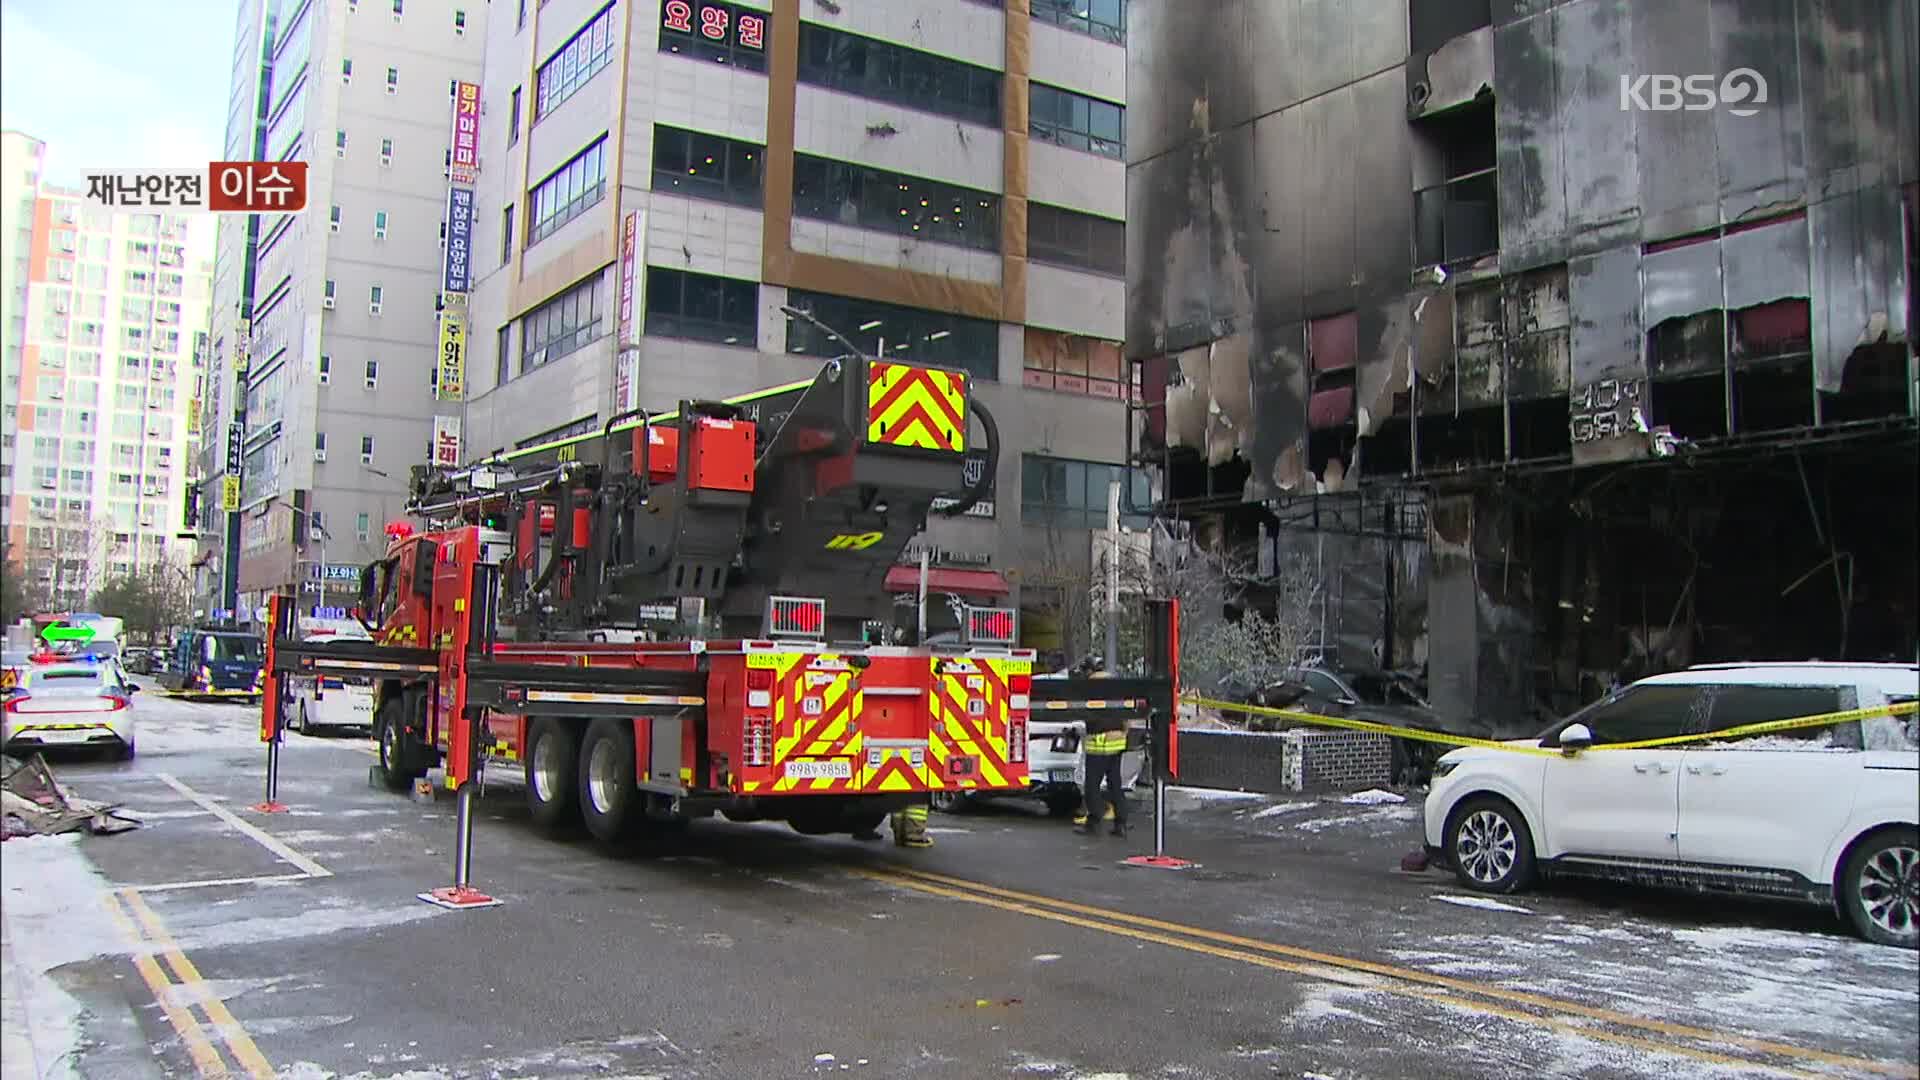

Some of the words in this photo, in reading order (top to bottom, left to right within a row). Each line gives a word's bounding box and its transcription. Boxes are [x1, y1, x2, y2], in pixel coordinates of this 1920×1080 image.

[664, 0, 764, 49] 요양원
[449, 239, 468, 278] 요양원
[824, 531, 883, 551] 119
